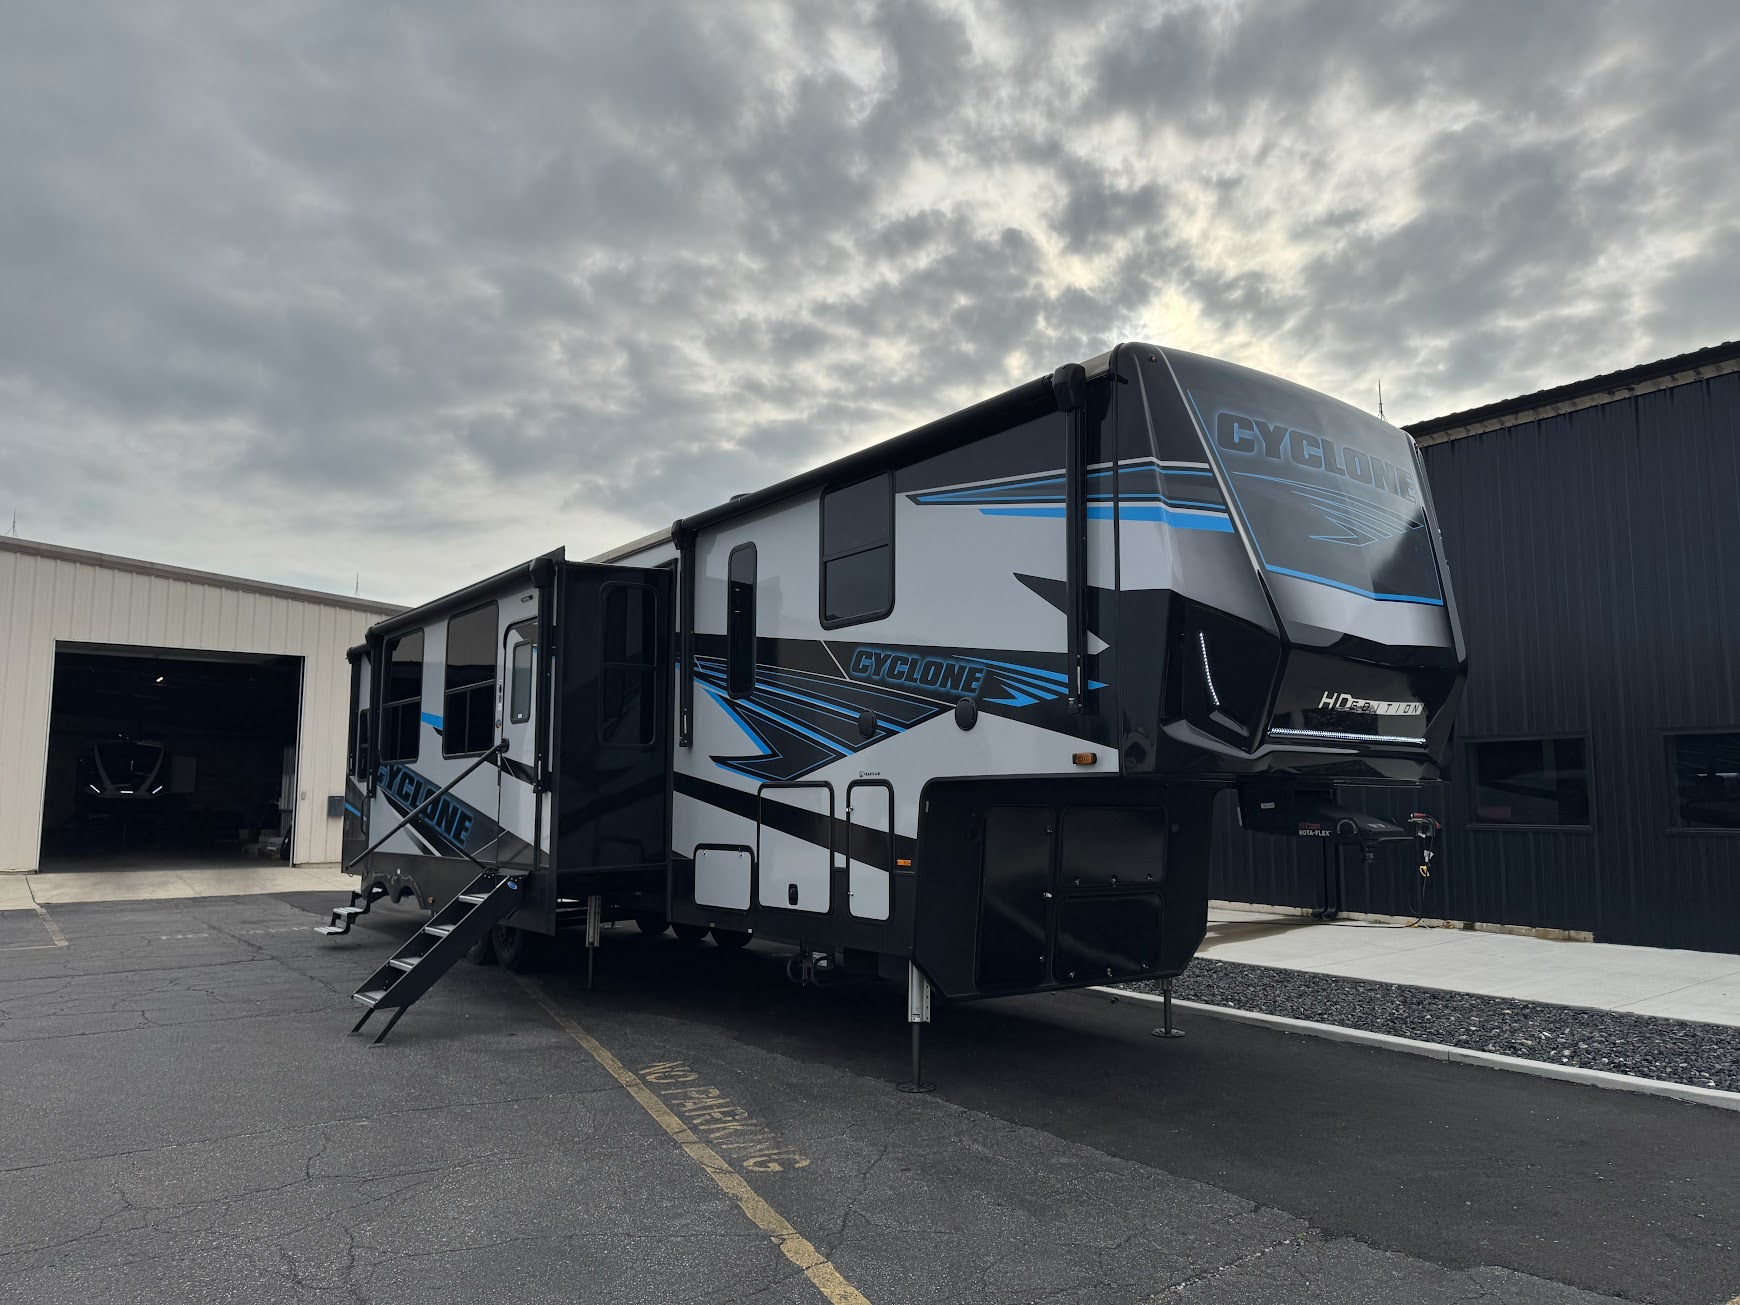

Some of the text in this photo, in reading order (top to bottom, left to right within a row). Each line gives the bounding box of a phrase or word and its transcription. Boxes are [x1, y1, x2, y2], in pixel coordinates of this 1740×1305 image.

[1216, 411, 1417, 504] CYCLONE
[851, 648, 986, 696] CYCLONE
[639, 1061, 699, 1083] NO
